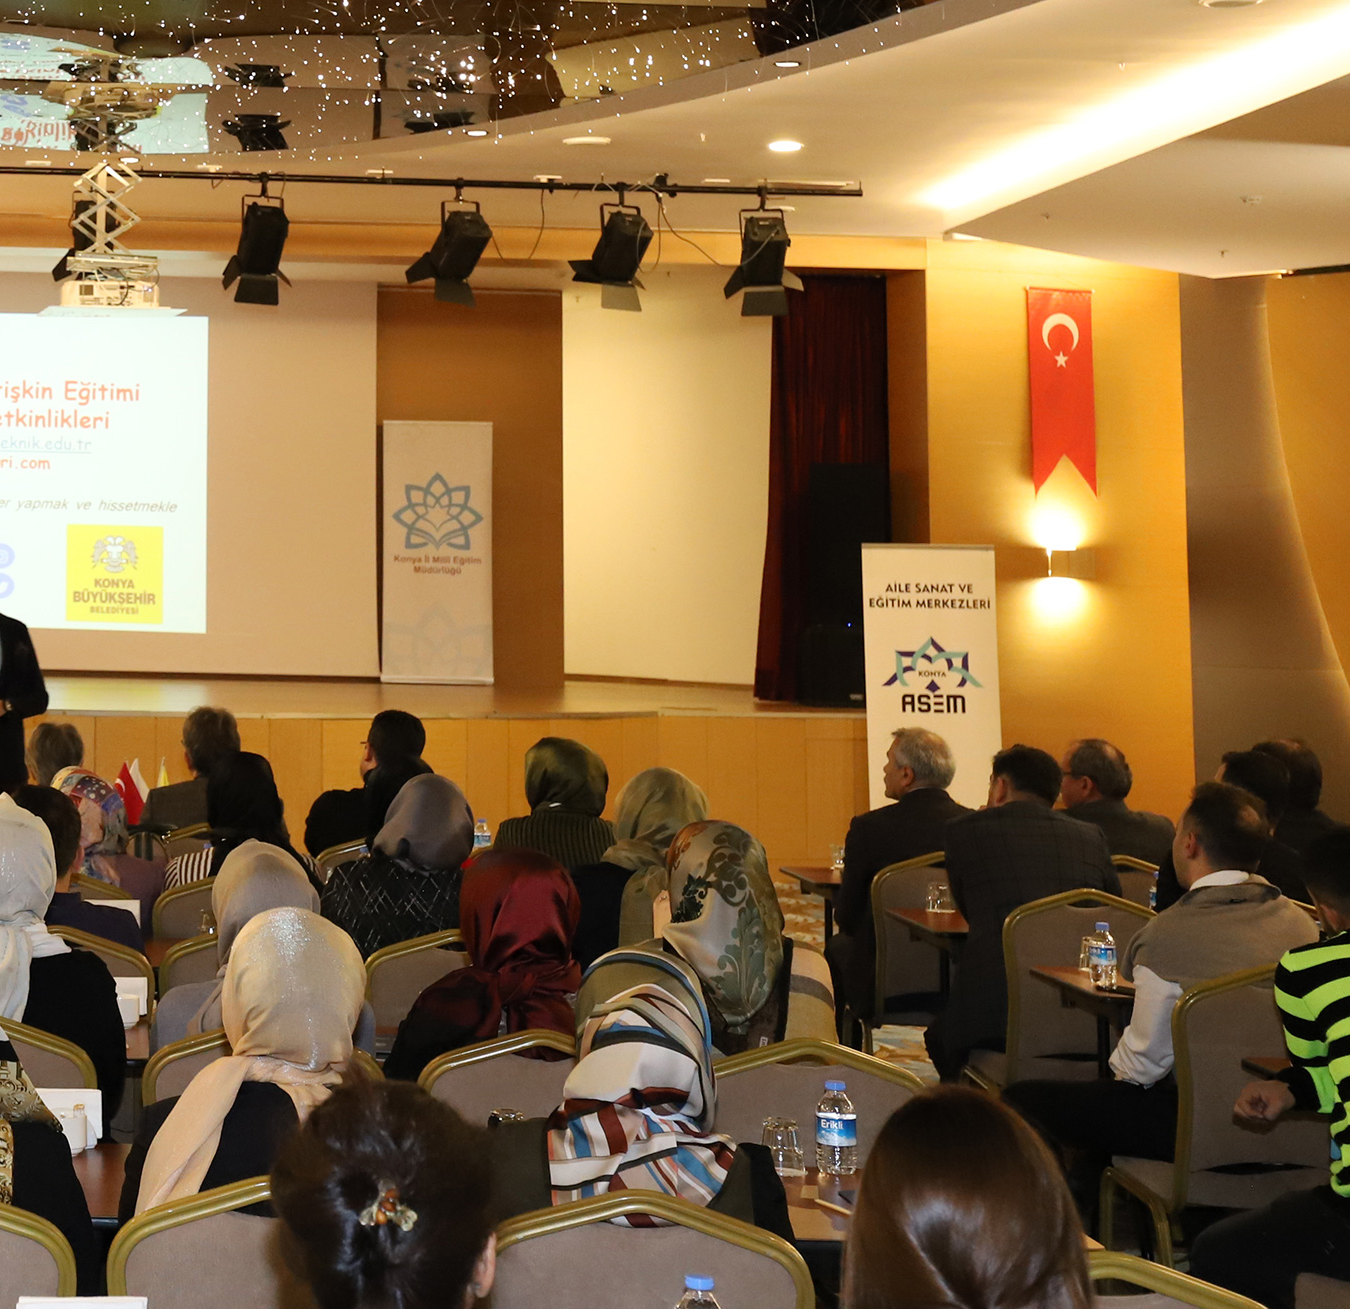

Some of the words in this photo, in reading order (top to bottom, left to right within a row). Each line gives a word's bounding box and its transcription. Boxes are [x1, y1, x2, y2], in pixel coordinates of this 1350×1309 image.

[64, 380, 141, 405] Eğitimi
[17, 498, 68, 513] yapmak
[76, 500, 92, 511] ve
[98, 499, 178, 514] hissetmekle
[393, 555, 422, 565] Konya
[453, 555, 482, 566] Eğitim
[413, 565, 462, 576] Müdürlüğü
[94, 578, 136, 589] KONYA
[885, 581, 911, 593] AİLE
[915, 583, 954, 593] SANAT
[958, 583, 973, 593] VE
[73, 588, 156, 606] BÜYÜKŞEHİR
[869, 595, 912, 608] EĞİTİM
[915, 597, 991, 609] MERKEZLERİ
[90, 605, 139, 615] BELEDİYESİ
[918, 670, 947, 678] KONYA
[901, 693, 966, 713] ASEM
[820, 1119, 843, 1130] Erikli
